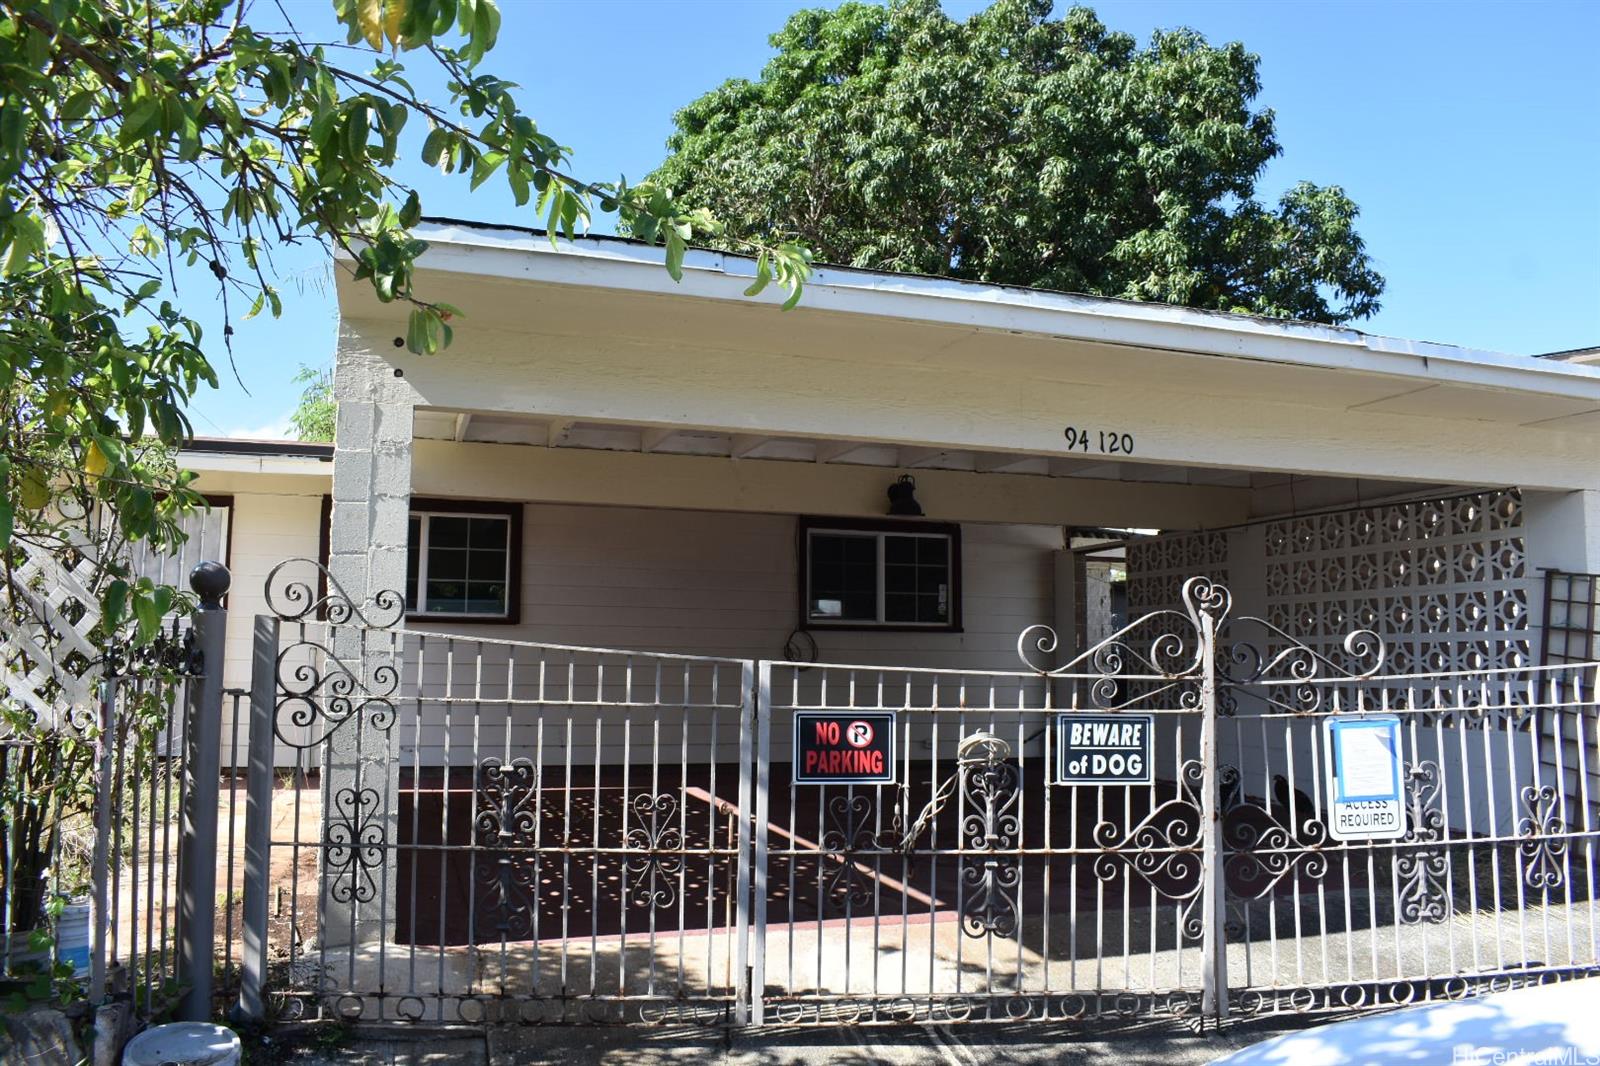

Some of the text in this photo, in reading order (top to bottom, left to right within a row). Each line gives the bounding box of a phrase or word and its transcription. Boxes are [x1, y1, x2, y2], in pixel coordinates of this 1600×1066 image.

[1064, 427, 1134, 454] 94 120
[815, 721, 840, 745] NO
[1070, 723, 1142, 746] BEWARE
[805, 750, 883, 774] PARKING
[1068, 753, 1142, 775] of DOG
[1340, 813, 1395, 827] REQUIRED
